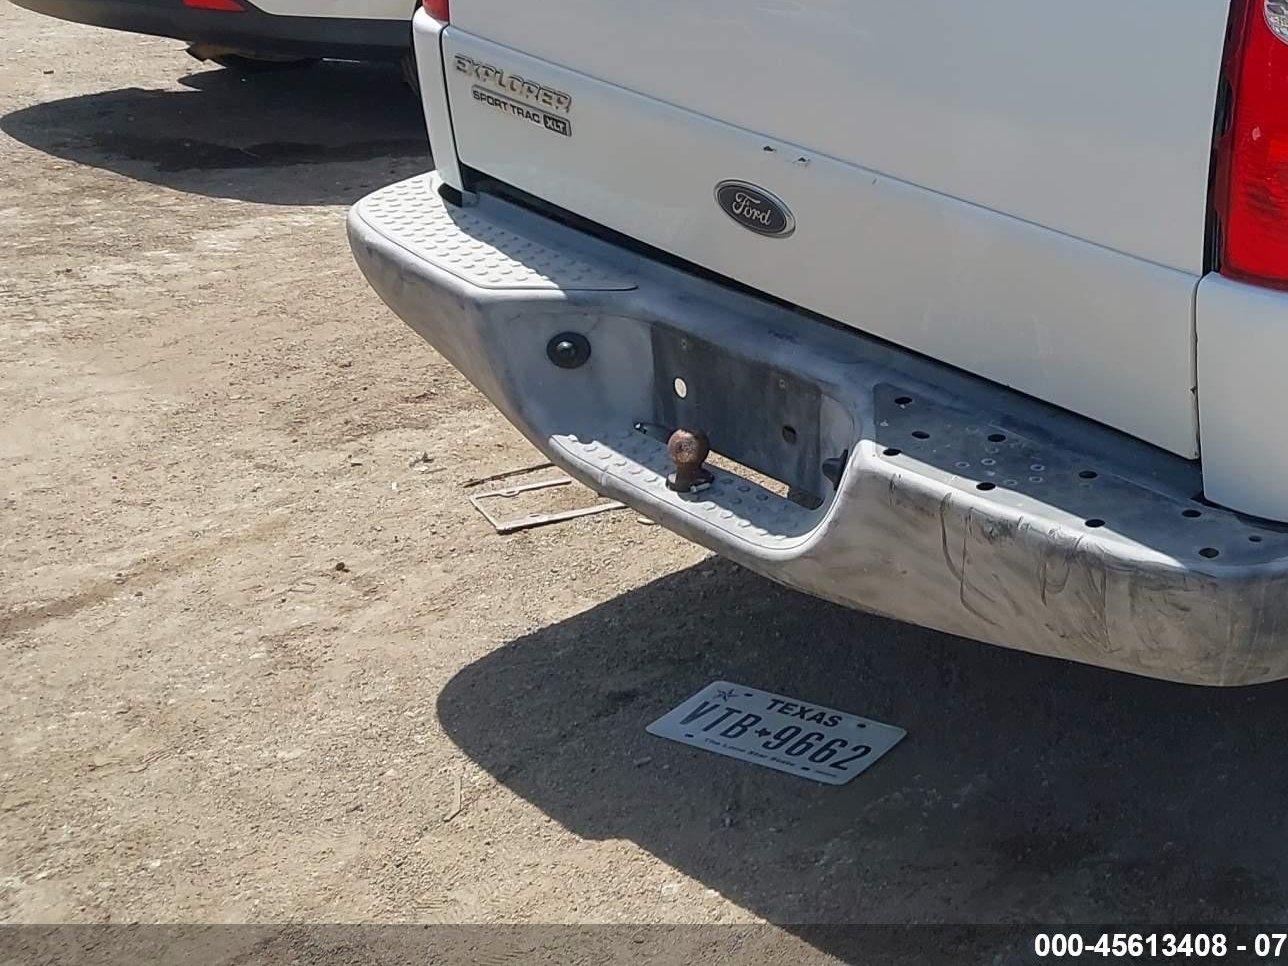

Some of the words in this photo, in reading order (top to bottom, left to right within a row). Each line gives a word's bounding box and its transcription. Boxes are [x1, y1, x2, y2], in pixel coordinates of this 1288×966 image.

[454, 54, 572, 113] EXPLORER
[472, 90, 508, 112] SPORT
[509, 104, 541, 124] TRAC
[545, 117, 567, 135] XLT
[732, 192, 771, 226] Ford
[766, 698, 842, 727] TEXAS
